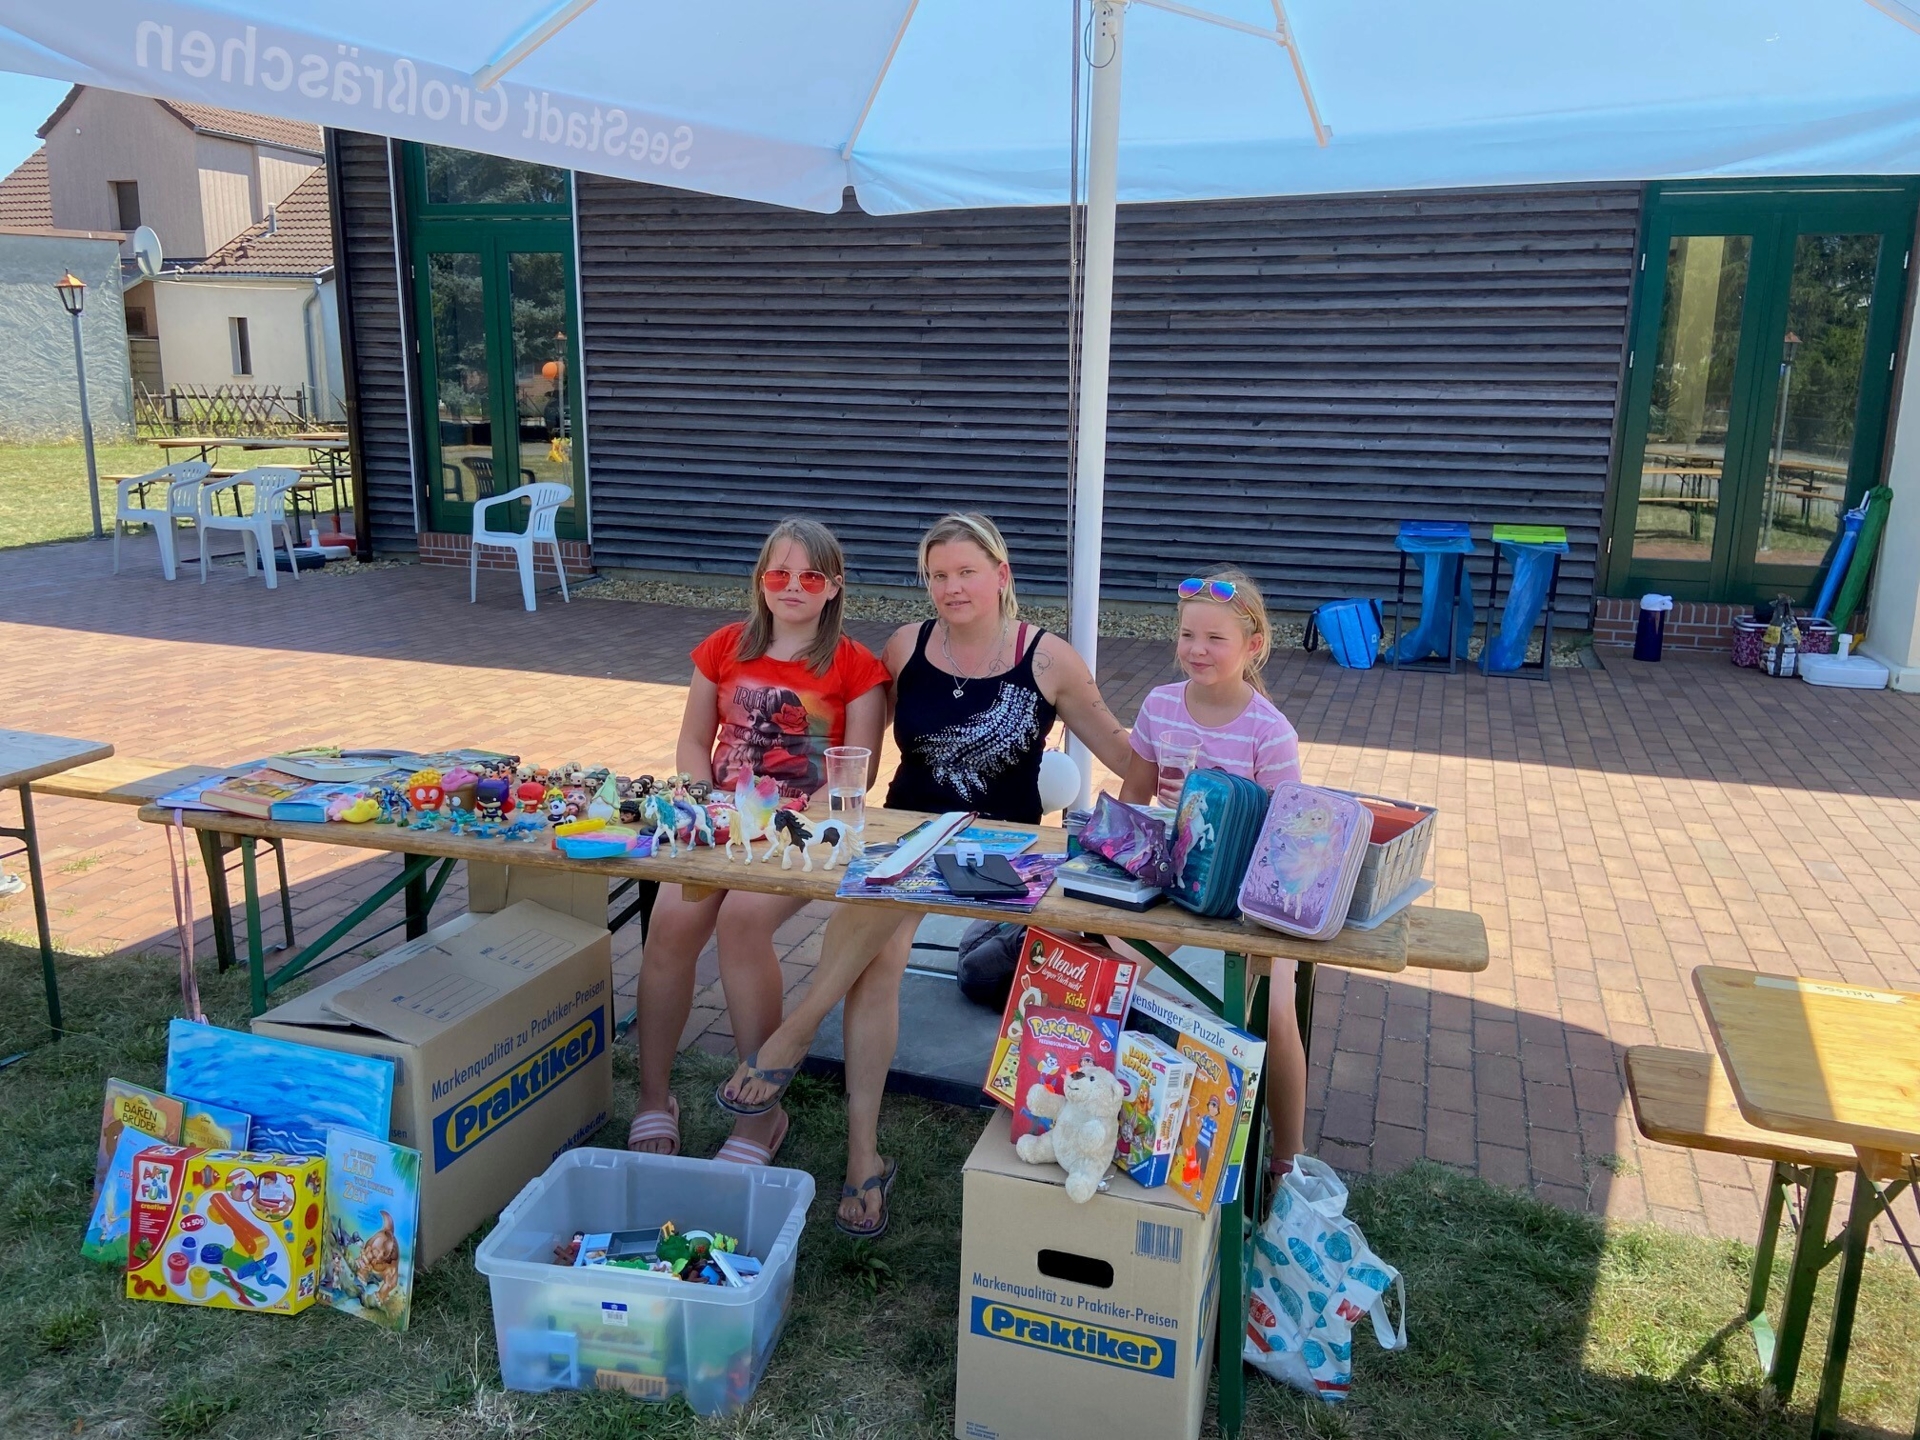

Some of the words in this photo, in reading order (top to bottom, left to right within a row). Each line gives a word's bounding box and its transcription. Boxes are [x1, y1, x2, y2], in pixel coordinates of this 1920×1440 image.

[1026, 947, 1090, 982] Mensch
[1064, 991, 1087, 1009] Kids
[1132, 993, 1184, 1026] vensburger
[1192, 1020, 1225, 1049] Puzzle
[432, 1037, 514, 1102] Markenqualität
[517, 1030, 529, 1048] zu
[531, 979, 605, 1038] Praktiker-Preisen
[454, 1026, 593, 1149] Praktiker
[143, 1165, 169, 1183] ART
[151, 1178, 158, 1187] &
[140, 1203, 167, 1212] creative
[141, 1183, 168, 1201] FUN
[972, 1272, 1058, 1303] Markenqualität
[1060, 1295, 1073, 1307] zu
[1077, 1295, 1179, 1329] Praktiker-Preisen
[991, 1306, 1158, 1366] Praktiker
